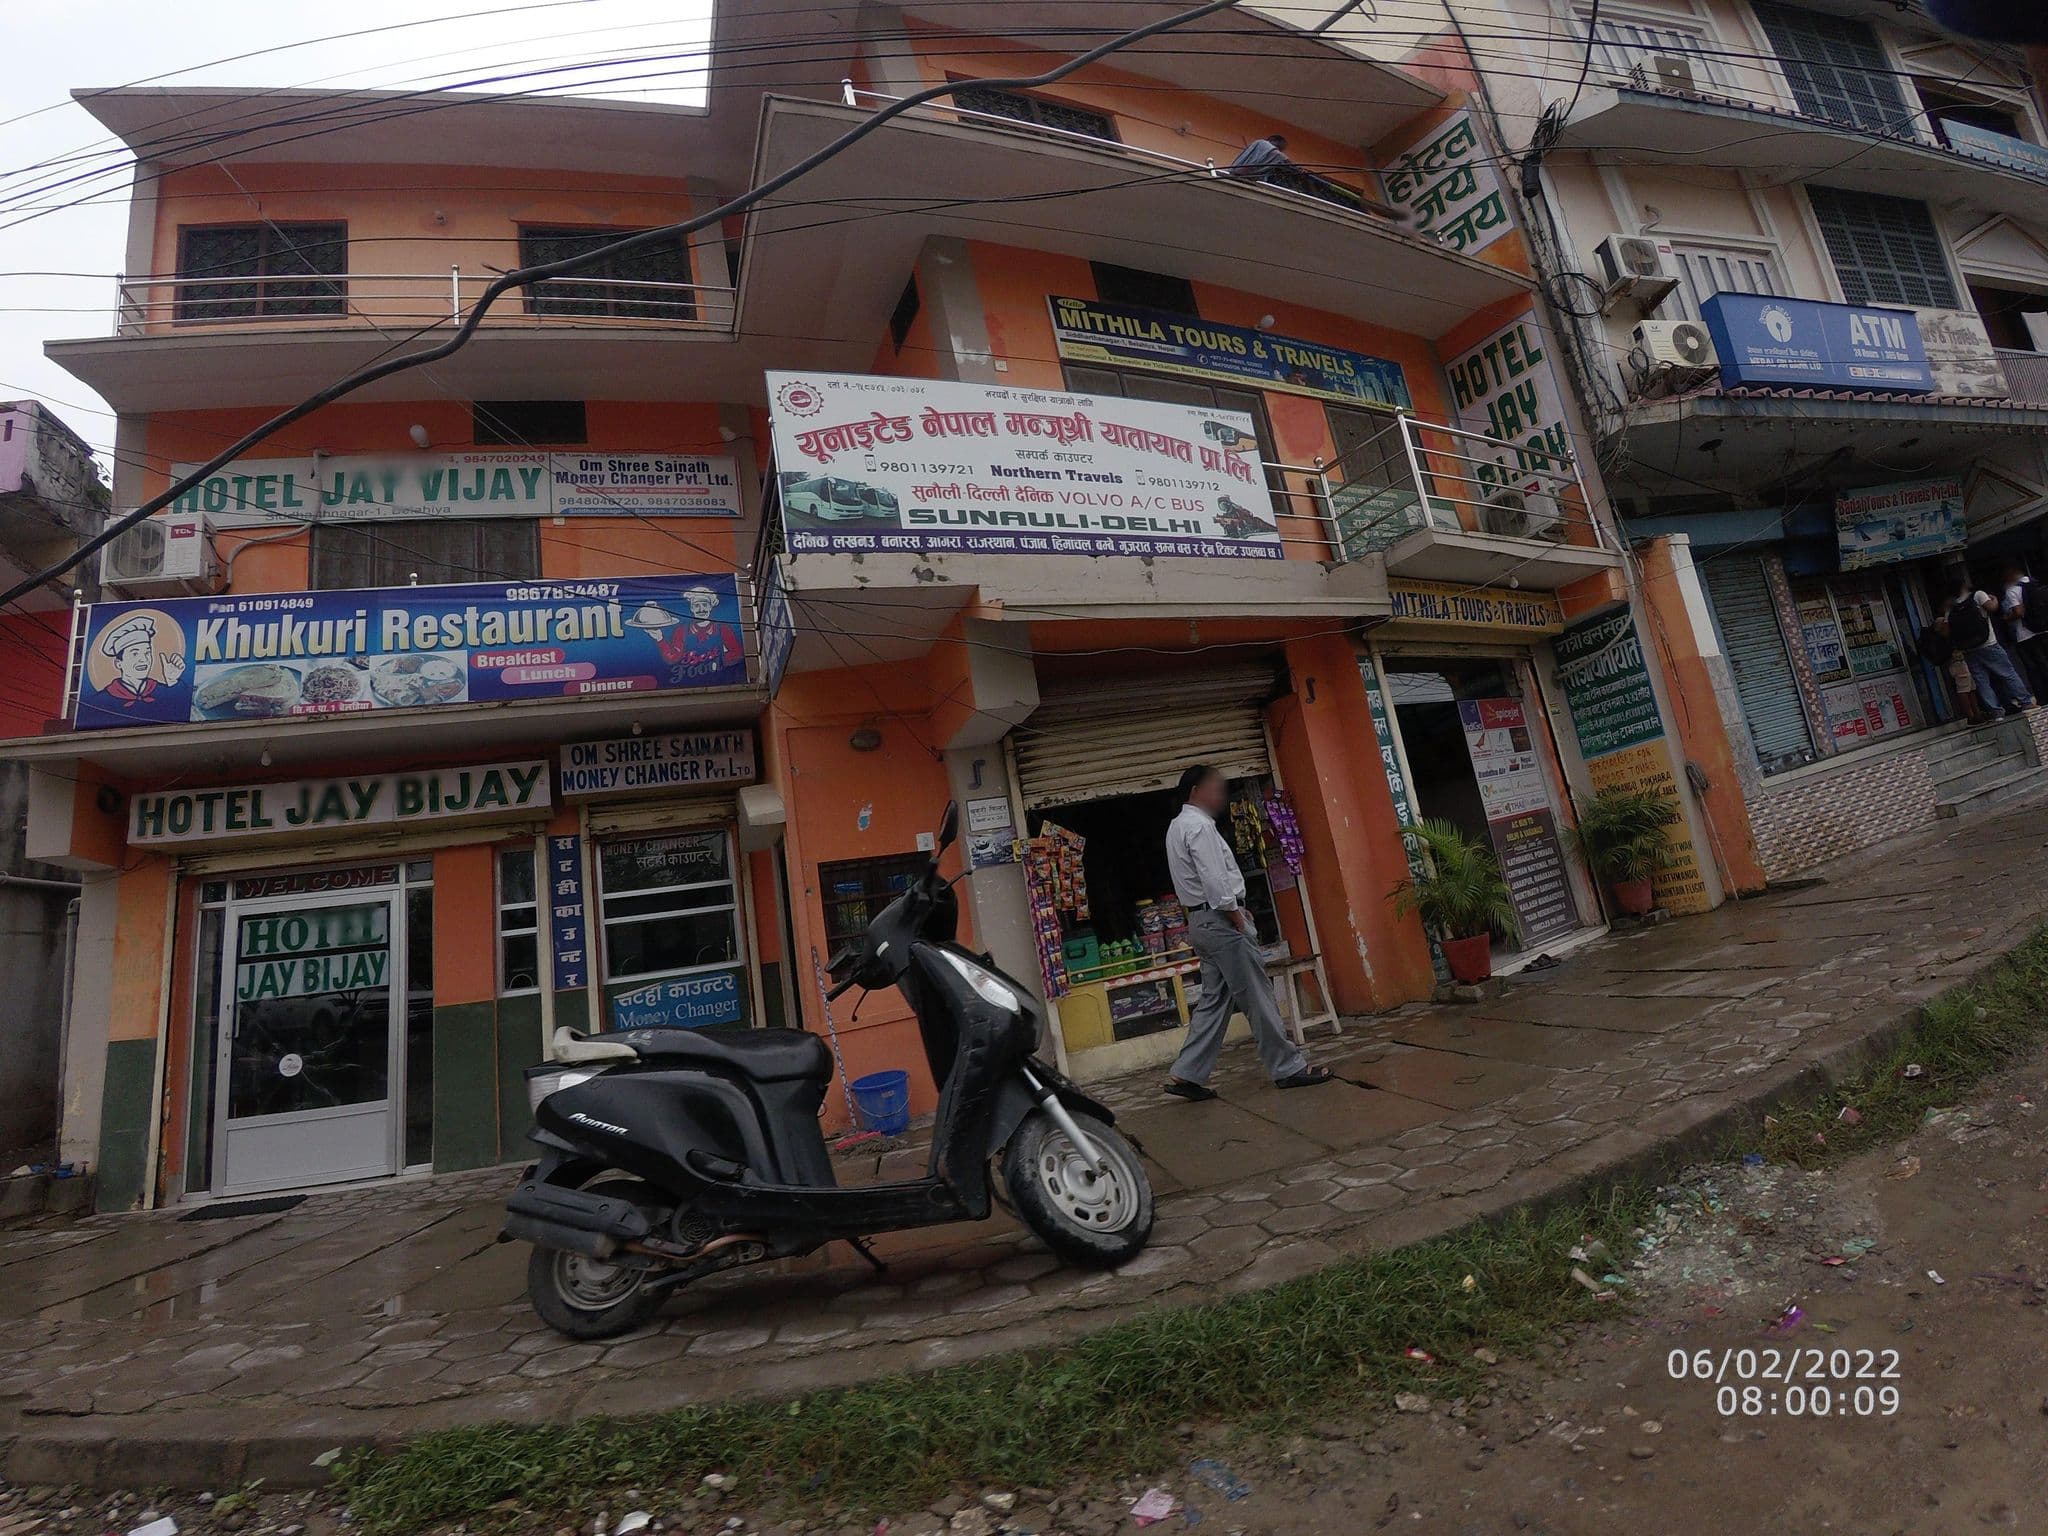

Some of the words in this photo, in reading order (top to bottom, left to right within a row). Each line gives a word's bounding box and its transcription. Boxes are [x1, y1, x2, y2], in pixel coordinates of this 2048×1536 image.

[1385, 116, 1479, 204] होटल
[1412, 159, 1479, 227] जय
[1058, 307, 1168, 342] MITHILA
[1169, 323, 1247, 356] TOURS
[1252, 339, 1269, 360] &
[1271, 342, 1356, 378] TRAVELS
[1849, 314, 1906, 350] ATM
[1450, 324, 1543, 409] HOTEL
[1484, 377, 1540, 448] JAY
[794, 411, 913, 464] यूनाइटेड
[919, 406, 998, 439] नेपाल
[1003, 411, 1094, 448] मन्जूश्री
[1098, 421, 1194, 465] यातायात
[464, 454, 546, 464] 9847020249
[579, 459, 602, 472] Om
[608, 460, 650, 473] Shree
[655, 460, 710, 473] Sainath
[880, 461, 975, 475] 9801139721
[1015, 448, 1049, 461] सम्पर्क
[1053, 451, 1095, 465] काउण्टर
[555, 471, 605, 486] Money
[610, 473, 671, 486] Changer
[675, 473, 703, 485] Pvt.
[707, 474, 733, 487] Ltd.
[990, 463, 1061, 481] Northern
[1065, 469, 1124, 485] Travels
[1148, 477, 1221, 491] 9801139712
[172, 474, 303, 514] HOTEL
[322, 469, 402, 506] JAY
[419, 467, 543, 504] VIJAY
[647, 498, 727, 507] 9847038083
[1016, 485, 1055, 504] दैनिक
[1058, 490, 1123, 508] VOLVO
[1130, 496, 1166, 510] A/C
[1171, 498, 1206, 513] BUS
[1899, 488, 1931, 507] Travels
[909, 508, 1202, 535] SUNAULI-DELHI
[792, 532, 830, 550] दैनिक
[237, 598, 314, 612] 610914849
[1389, 592, 1451, 619] MITHILA
[1451, 596, 1493, 624] TOURS
[1500, 600, 1547, 627] TRAVELS
[195, 609, 369, 662] Khukuri
[382, 598, 625, 652] Restaurant
[1583, 624, 1604, 647] बस
[477, 650, 557, 668] Breakfast
[520, 667, 576, 682] Lunch
[580, 678, 634, 693] Dinner
[571, 745, 598, 766] OM
[605, 740, 664, 763] SHREE
[670, 734, 745, 757] SAINATH
[562, 766, 620, 792] MONEY
[625, 760, 701, 786] CHANGER
[1627, 760, 1657, 775] TOURS
[1639, 772, 1673, 788] POKHARA
[137, 788, 272, 839] HOTEL
[286, 779, 380, 824] JAY
[396, 764, 542, 816] BIJAY
[645, 835, 702, 852] CHANGER
[635, 853, 667, 868] सटही
[668, 850, 714, 866] काउण्टर
[243, 865, 397, 898] WELCOME
[246, 904, 384, 955] HOTEL
[239, 961, 297, 1000] JAY
[303, 951, 386, 993] BIJAY
[668, 973, 736, 1000] काउन्टर
[618, 1010, 671, 1030] Money
[674, 998, 738, 1020] Changer
